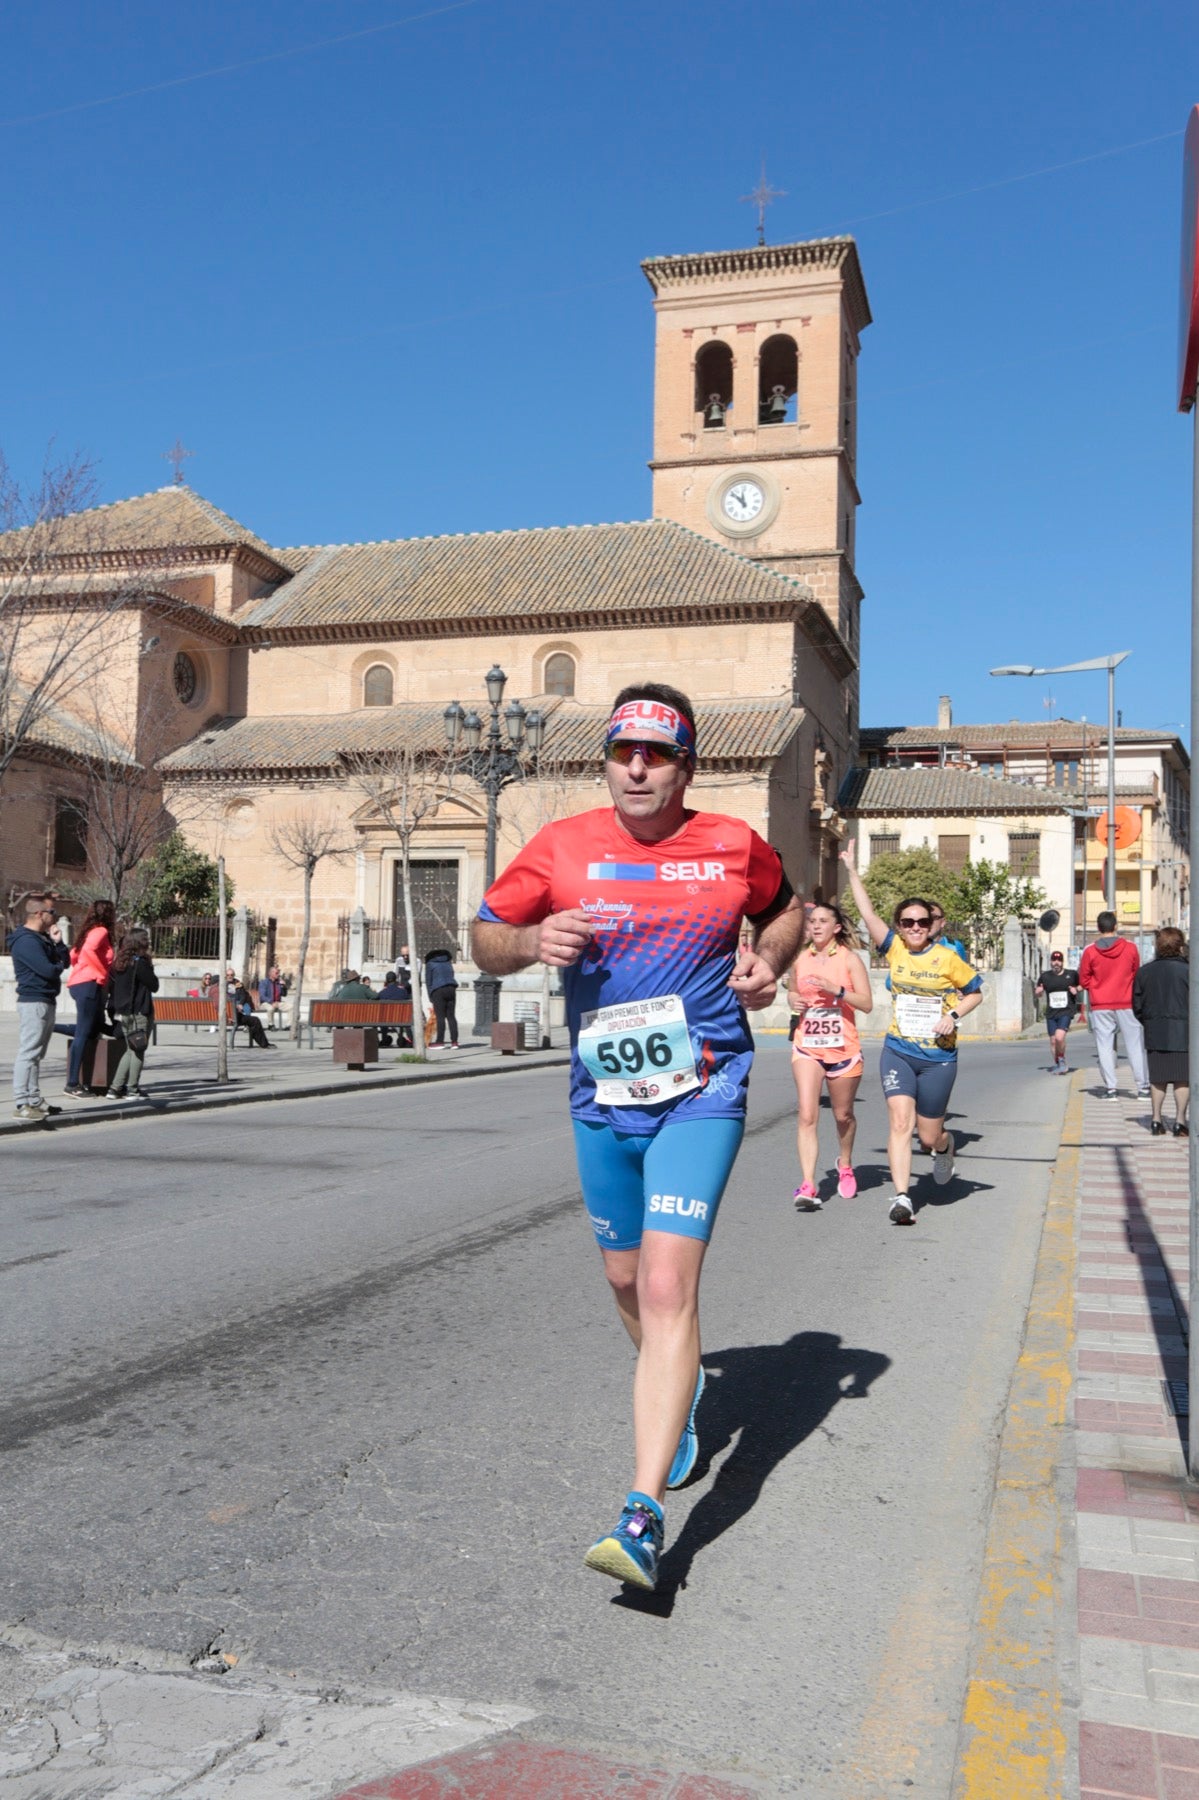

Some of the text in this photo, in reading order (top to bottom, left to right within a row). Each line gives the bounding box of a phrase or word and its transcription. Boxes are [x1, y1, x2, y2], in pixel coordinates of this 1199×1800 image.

[610, 702, 676, 729] SEUR
[660, 862, 725, 881] SEUR
[601, 1010, 614, 1021] GRAN
[614, 1006, 639, 1018] PREMIO
[641, 1003, 650, 1014] DE
[805, 1020, 841, 1035] 2255
[597, 1033, 673, 1074] 596
[649, 1194, 708, 1220] SEUR
